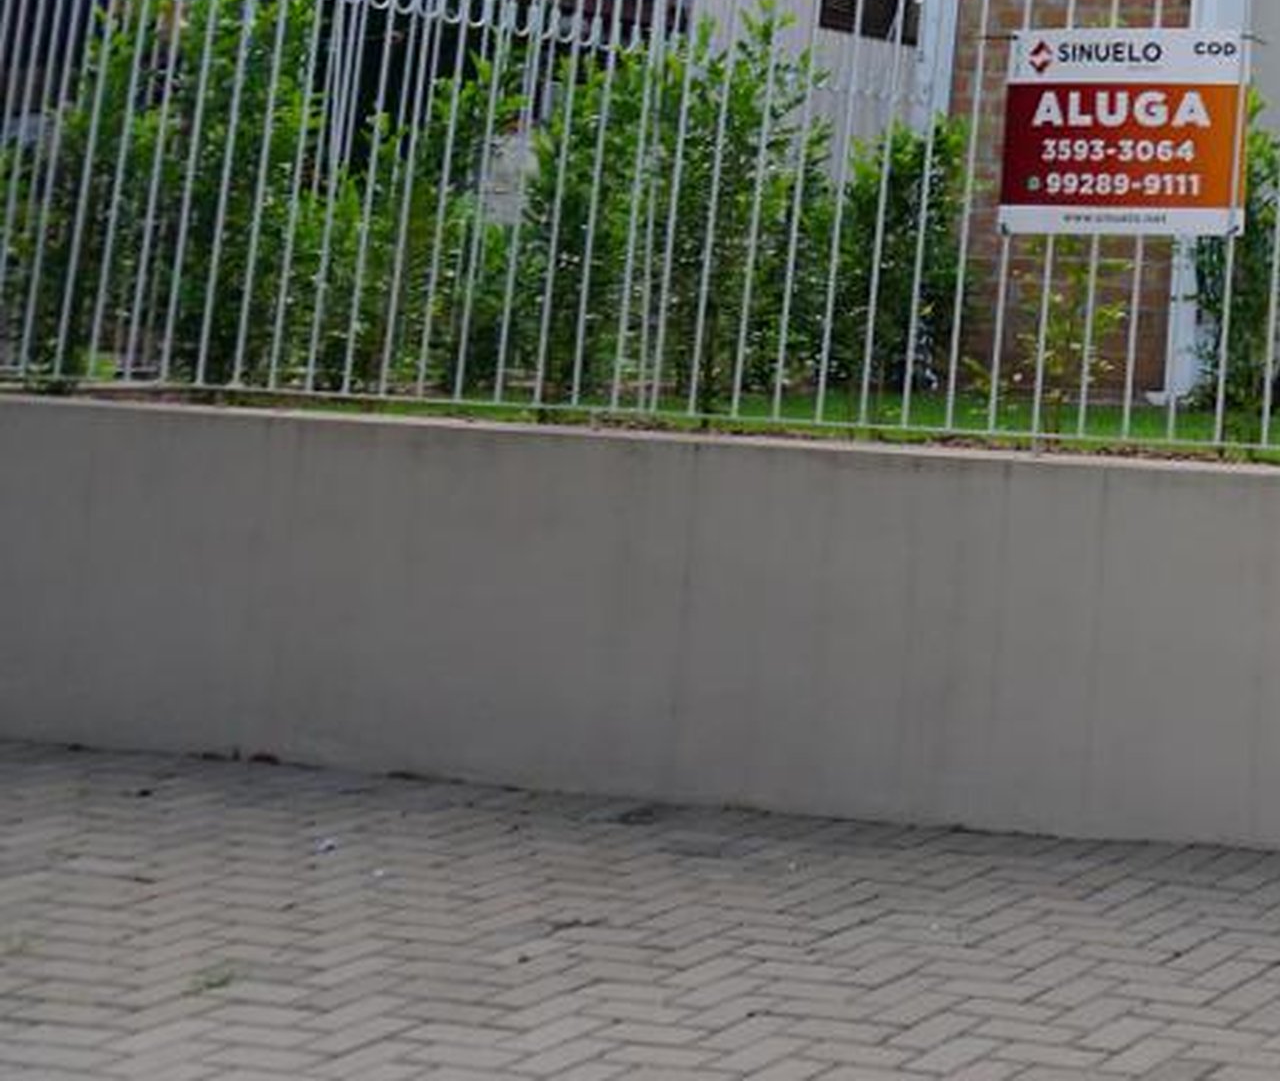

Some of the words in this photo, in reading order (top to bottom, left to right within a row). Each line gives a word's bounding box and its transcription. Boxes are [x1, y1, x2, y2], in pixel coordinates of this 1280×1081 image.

[1057, 42, 1163, 64] SINUELO
[1194, 41, 1237, 57] COD
[1032, 89, 1211, 128] ALUGA
[1041, 139, 1195, 162] 3593-3064
[1046, 172, 1201, 196] 99289-9111
